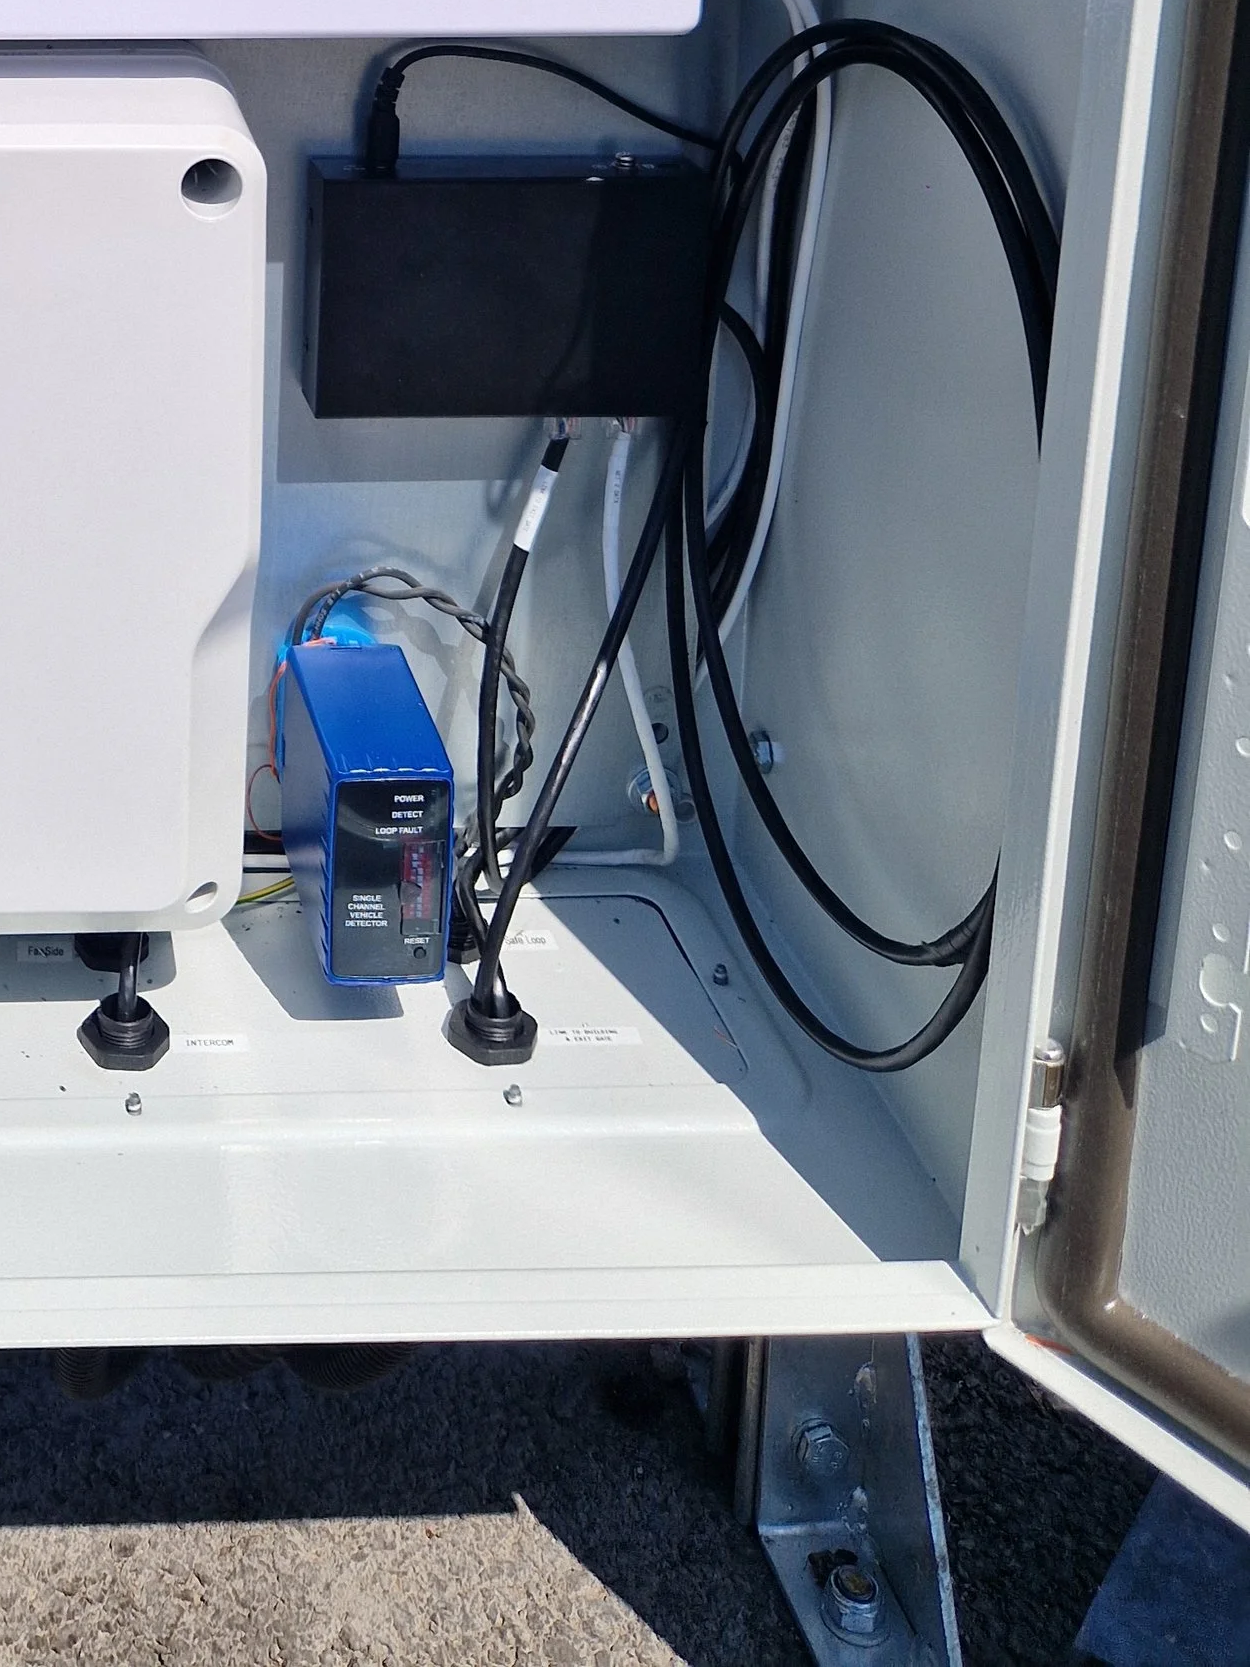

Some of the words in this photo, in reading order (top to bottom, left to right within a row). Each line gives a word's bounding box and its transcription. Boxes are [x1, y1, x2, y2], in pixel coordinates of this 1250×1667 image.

[394, 795, 424, 803] POWER
[391, 810, 424, 819] DETECT
[375, 827, 398, 835] LOOP
[398, 826, 424, 835] FAULT
[352, 894, 382, 903] SINGLE
[347, 903, 385, 911] CHANNEL
[349, 911, 384, 920] VEHICLE
[345, 919, 388, 928] DETECTOR
[404, 936, 430, 945] RESET
[45, 945, 65, 957] Side
[186, 1039, 234, 1047] INTERCOM
